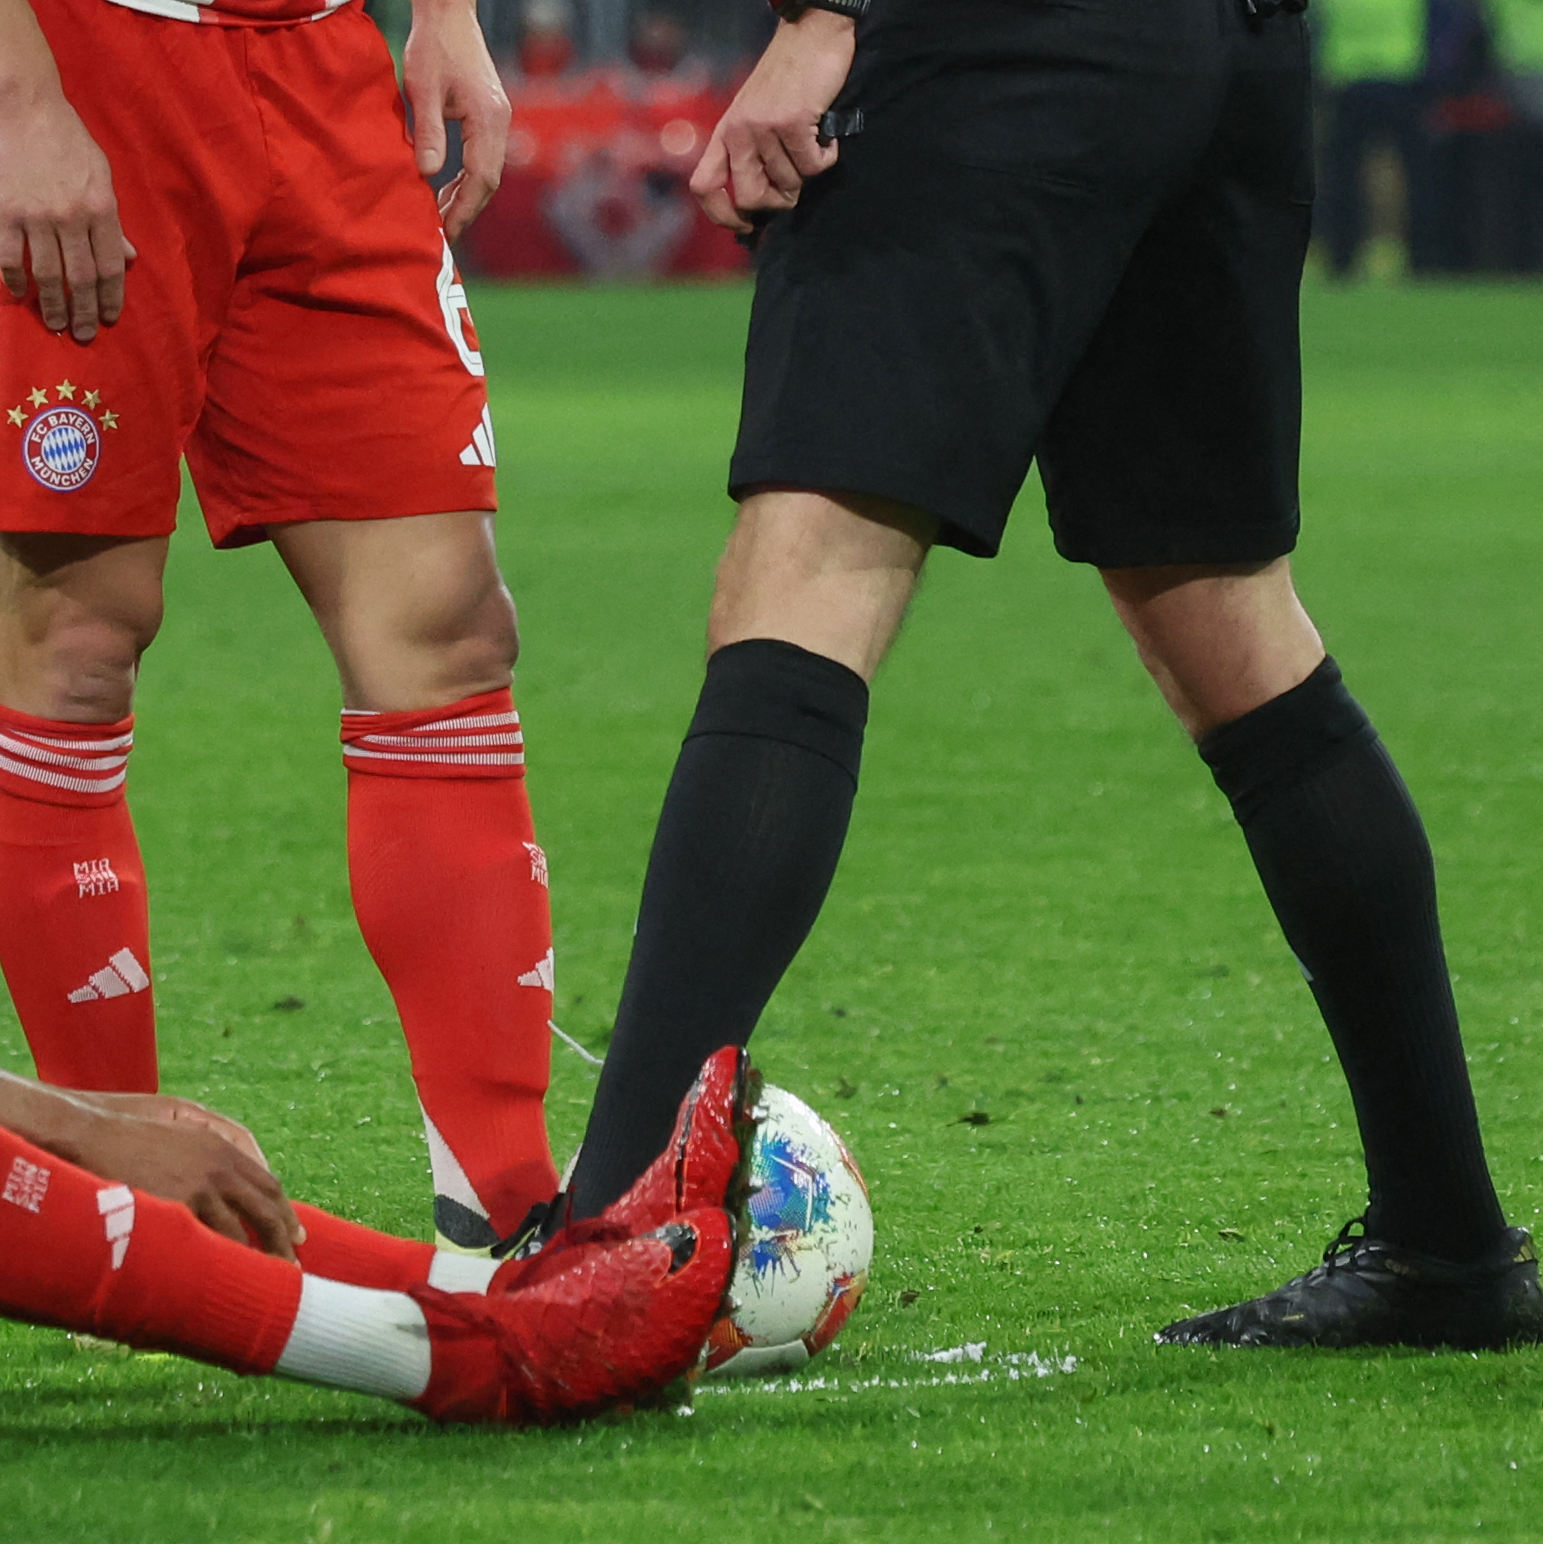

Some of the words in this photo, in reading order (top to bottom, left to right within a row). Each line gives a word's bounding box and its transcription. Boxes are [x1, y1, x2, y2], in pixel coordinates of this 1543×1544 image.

[30, 423, 48, 443] FC
[47, 413, 95, 445] BAYERN
[31, 455, 94, 486] MÜNCHEN
[78, 878, 119, 899] MIA
